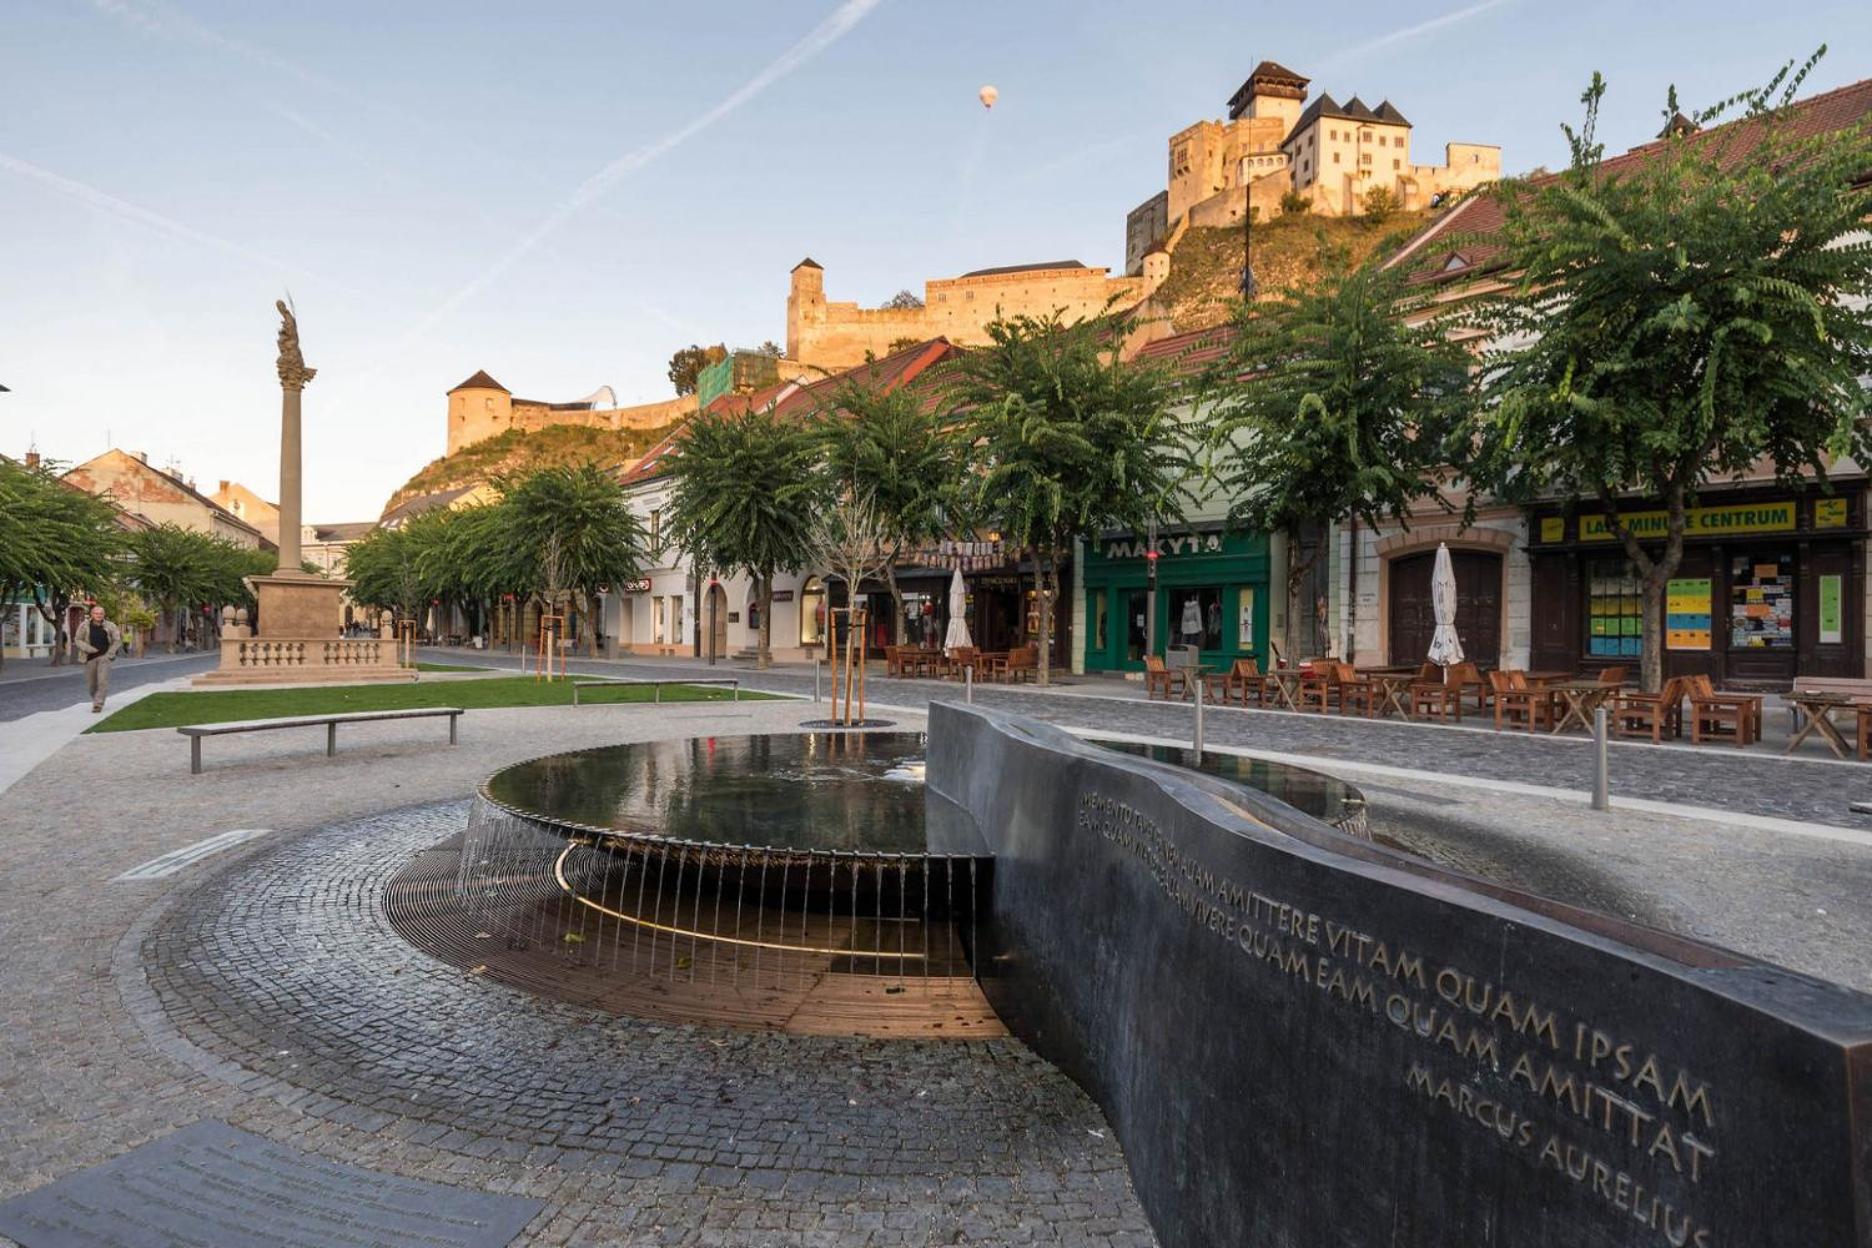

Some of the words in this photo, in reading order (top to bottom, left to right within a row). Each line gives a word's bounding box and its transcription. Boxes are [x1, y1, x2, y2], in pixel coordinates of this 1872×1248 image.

[1107, 535, 1222, 559] MAKYTA
[1700, 508, 1789, 529] CENTRUM
[1217, 878, 1320, 944] AMITTERE
[1326, 921, 1426, 990] VITAM
[1435, 967, 1560, 1050] QUAM
[1575, 1021, 1714, 1128] IPSAM
[1238, 923, 1311, 983] QUAM
[1315, 956, 1378, 1014] EAM
[1385, 993, 1499, 1073] QUAM
[1509, 1051, 1715, 1183] AMITTAT
[1406, 1062, 1532, 1147] MARCUS
